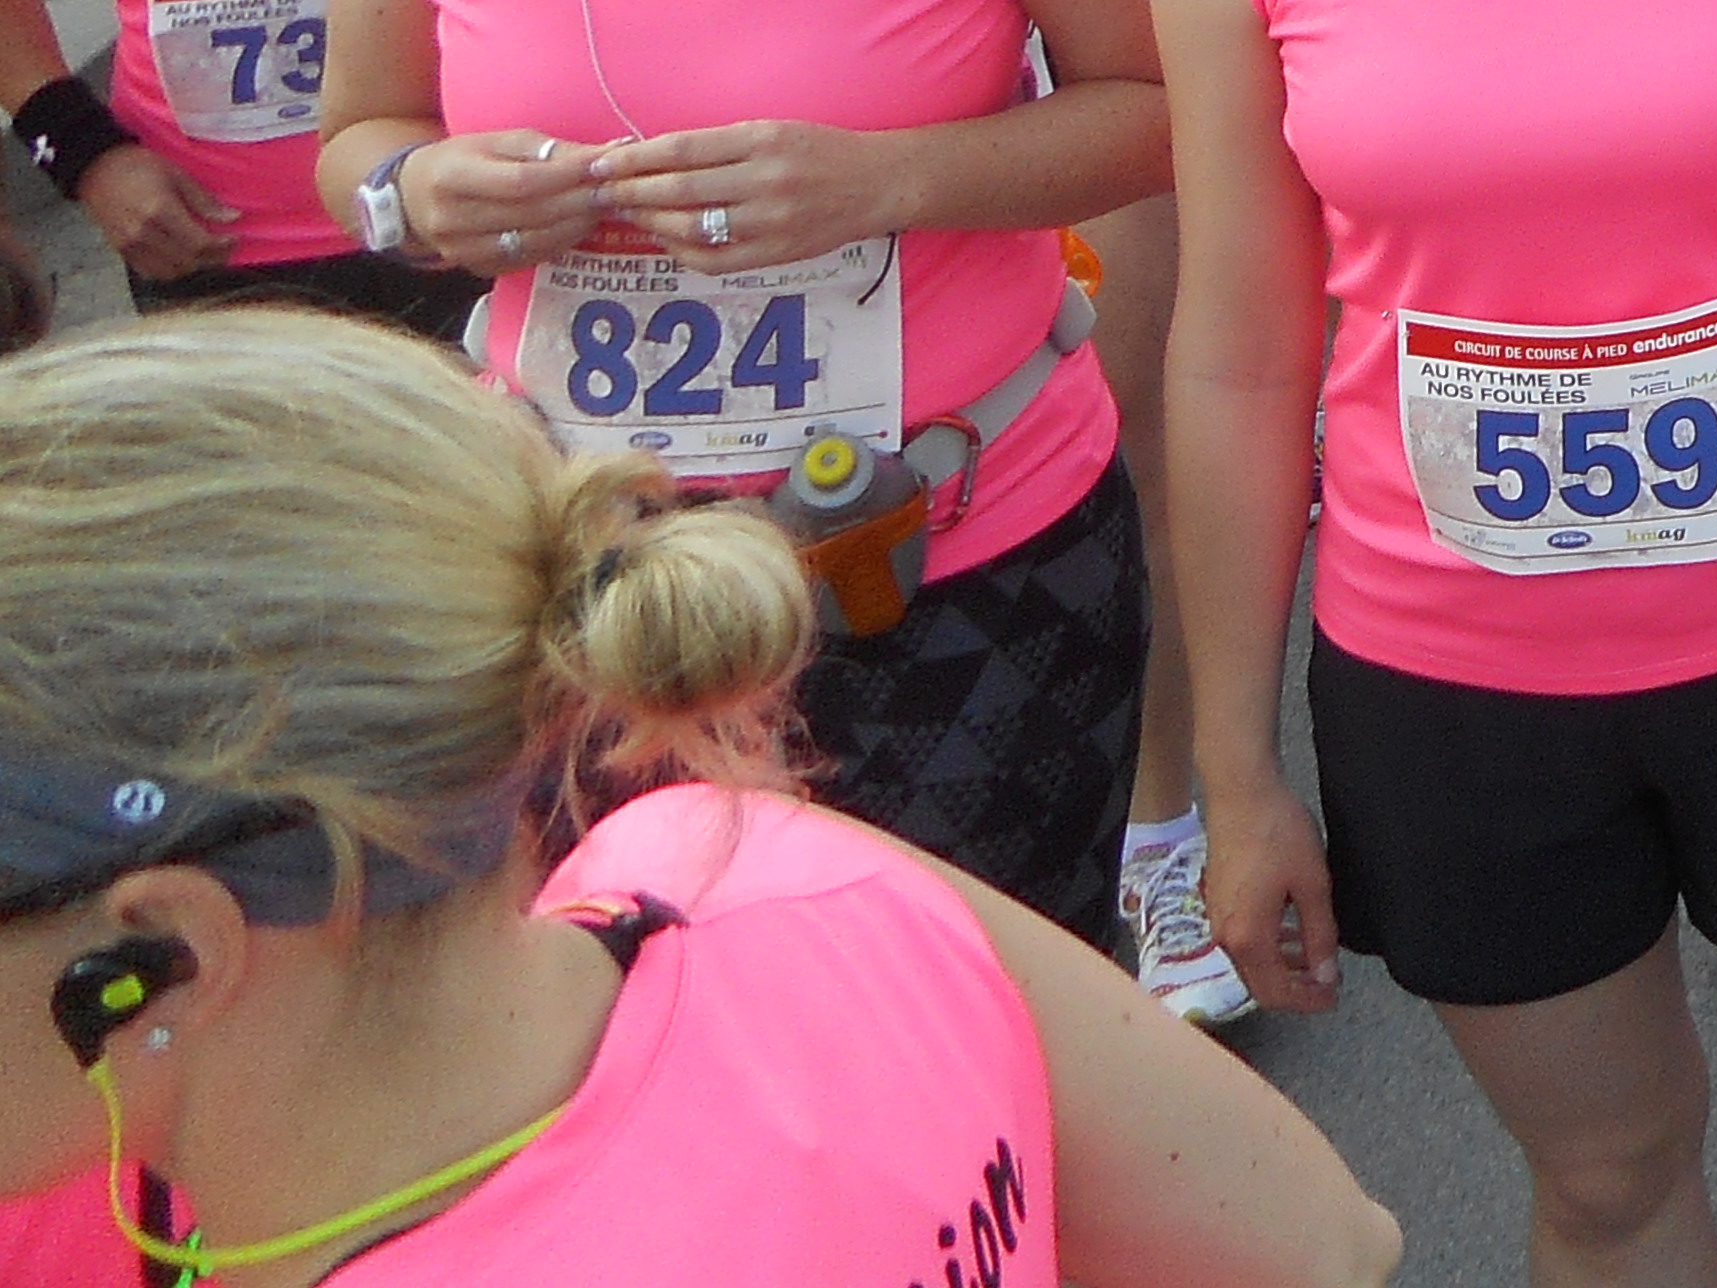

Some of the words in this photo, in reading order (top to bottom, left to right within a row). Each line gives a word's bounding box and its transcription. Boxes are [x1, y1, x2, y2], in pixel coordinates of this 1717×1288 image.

[211, 17, 327, 105] 73
[582, 274, 680, 292] FOULÉES
[567, 293, 819, 418] 824
[1454, 339, 1501, 358] CIRCUIT
[1505, 345, 1523, 360] DE
[1525, 346, 1579, 360] COURSE
[1582, 341, 1594, 360] À
[1597, 343, 1628, 359] PIED
[1421, 362, 1450, 379] AU
[1456, 366, 1552, 388] RYTHME
[1560, 372, 1592, 387] DE
[1427, 381, 1474, 400] NOS
[1480, 386, 1587, 405] FOULÉES
